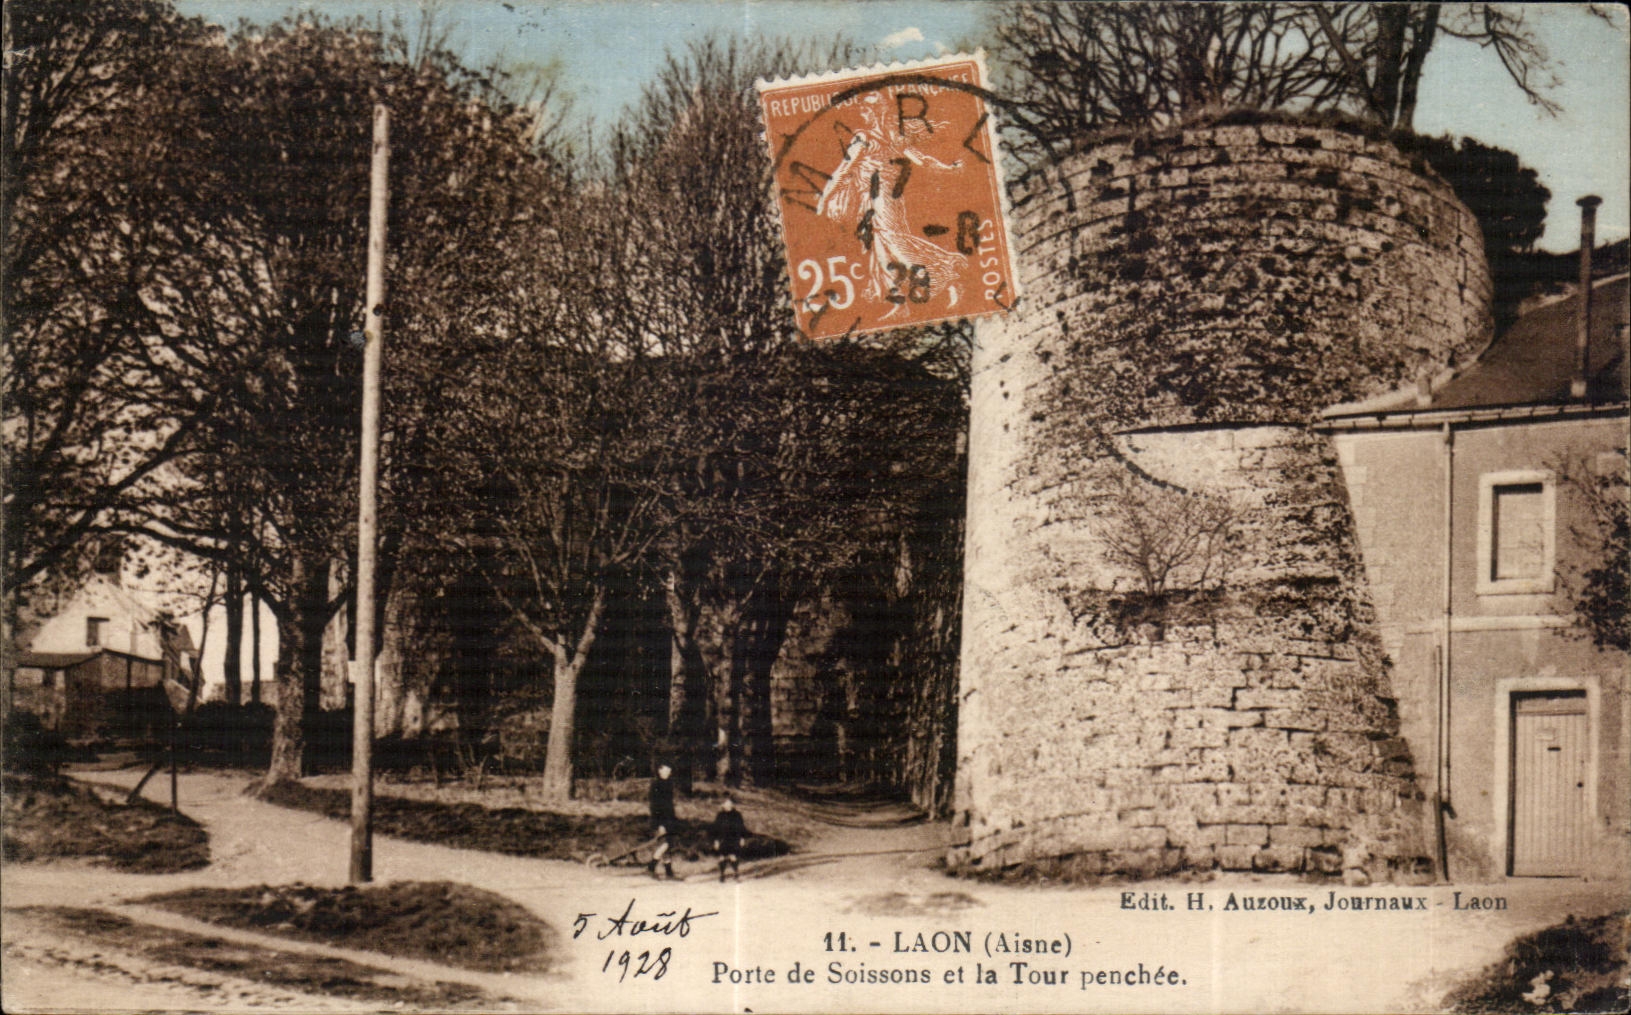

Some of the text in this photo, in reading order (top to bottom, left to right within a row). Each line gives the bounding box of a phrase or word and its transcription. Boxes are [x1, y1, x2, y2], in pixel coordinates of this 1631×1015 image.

[978, 219, 1004, 301] POSTES
[573, 912, 597, 940] 5
[602, 946, 672, 983] 1928
